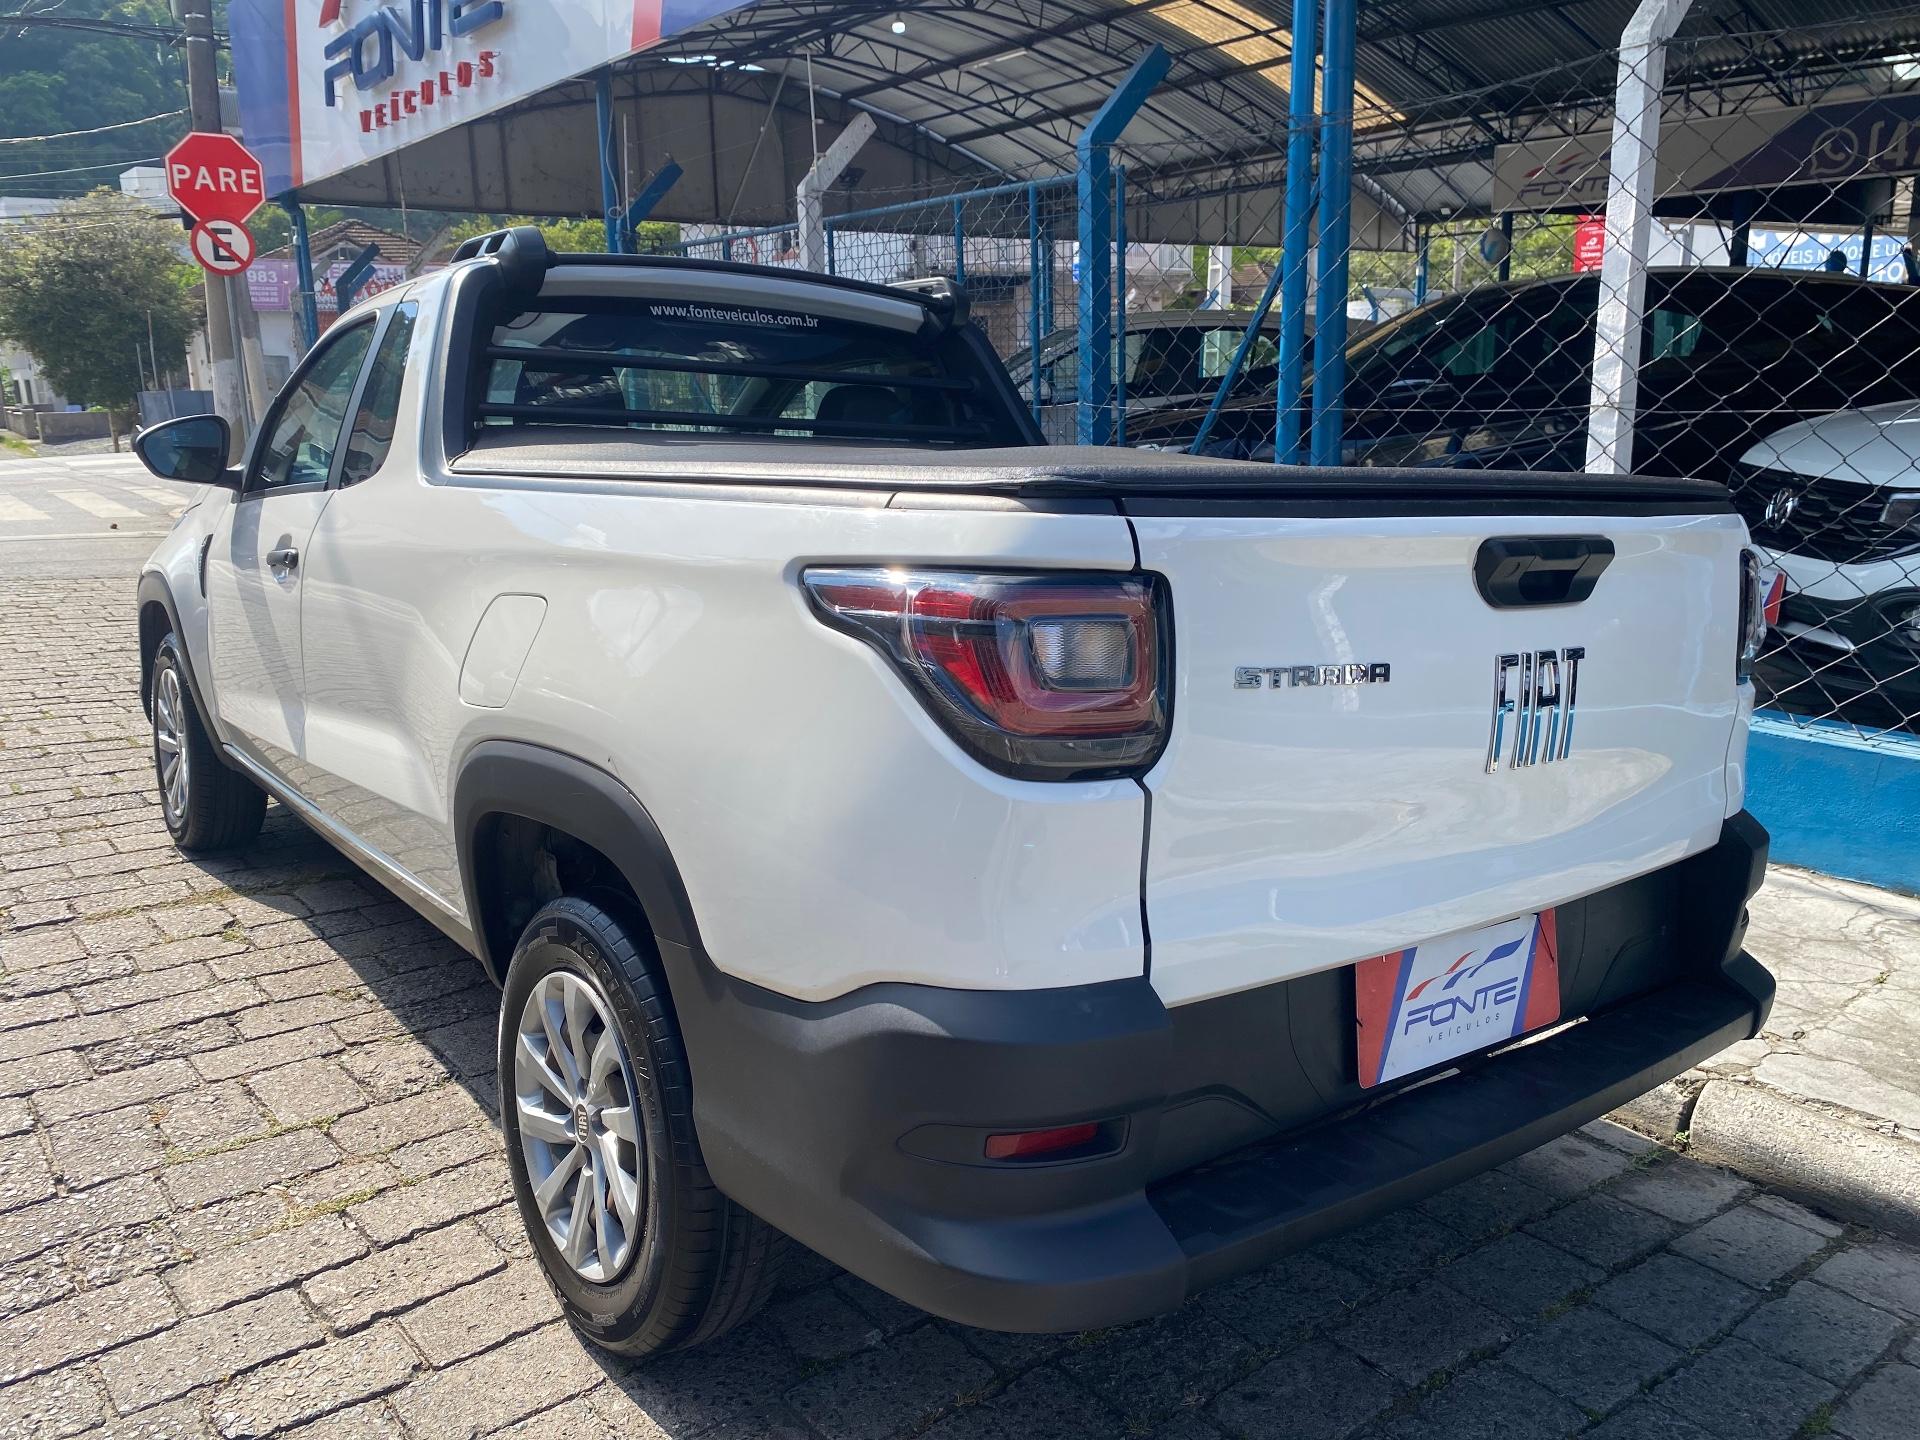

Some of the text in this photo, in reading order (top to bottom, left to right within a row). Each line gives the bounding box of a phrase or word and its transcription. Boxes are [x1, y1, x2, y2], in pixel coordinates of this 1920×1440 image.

[171, 163, 260, 194] PARE
[1872, 244, 1881, 257] E
[246, 270, 278, 283] 983
[649, 304, 819, 328] www.fonteveiculos.com.br
[1234, 662, 1391, 690] STRADA
[1485, 646, 1586, 775] FIAT
[1404, 976, 1519, 1036] FONTE
[577, 1109, 588, 1137] FIAT
